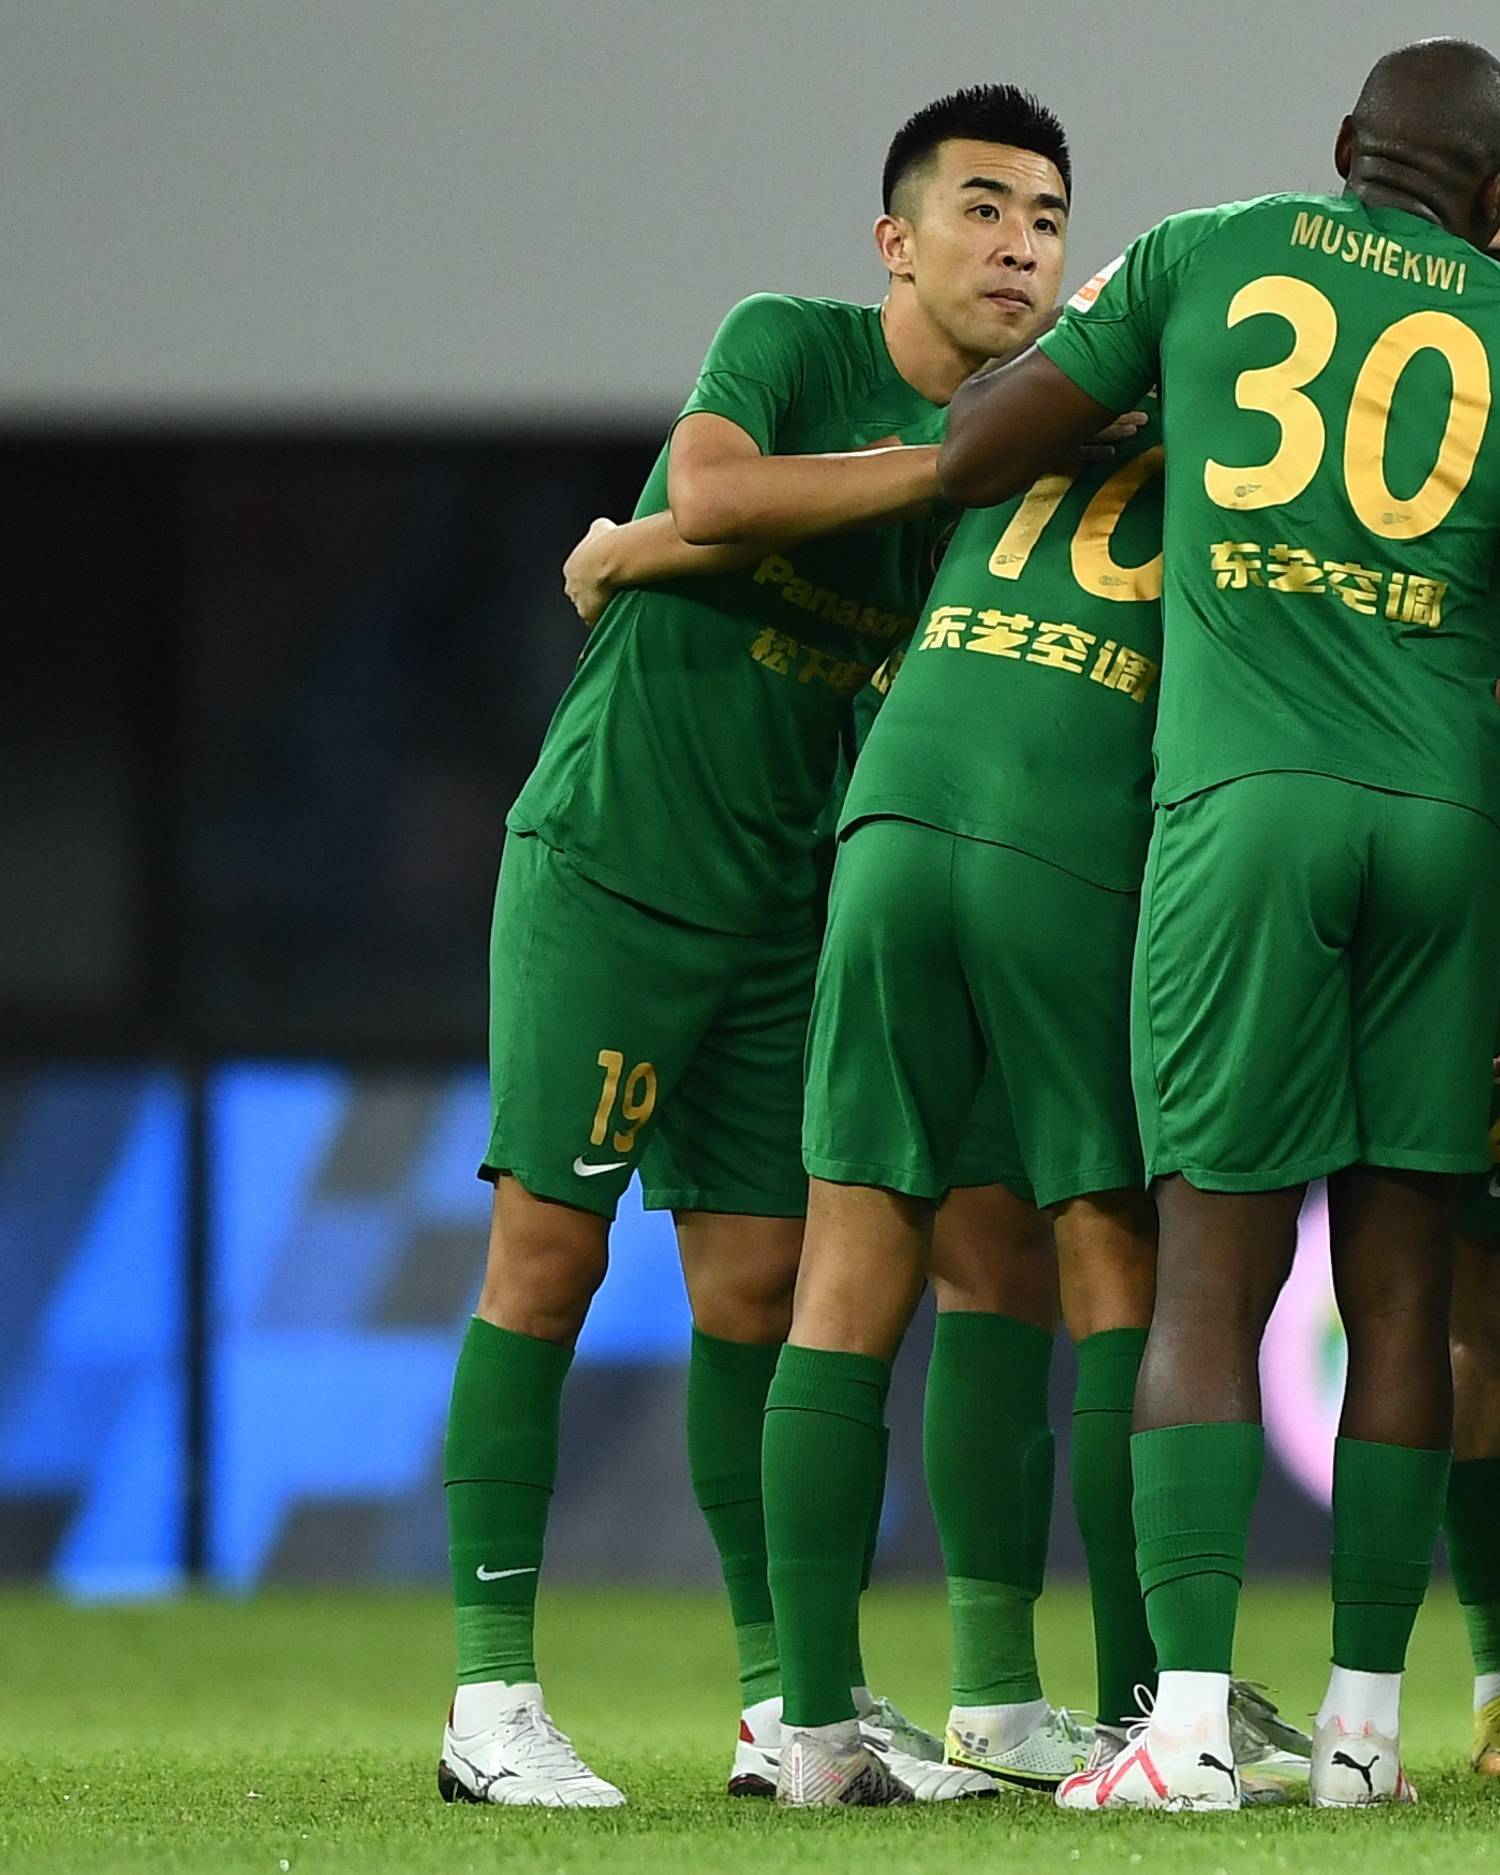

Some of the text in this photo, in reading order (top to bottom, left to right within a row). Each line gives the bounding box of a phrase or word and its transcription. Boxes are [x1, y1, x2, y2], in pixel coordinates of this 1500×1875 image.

[1289, 211, 1467, 296] MUSHEKWI
[1204, 275, 1492, 541] 30
[1210, 540, 1449, 629] 东芝空调
[918, 606, 1160, 704] 东芝空调
[590, 1049, 657, 1153] 19
